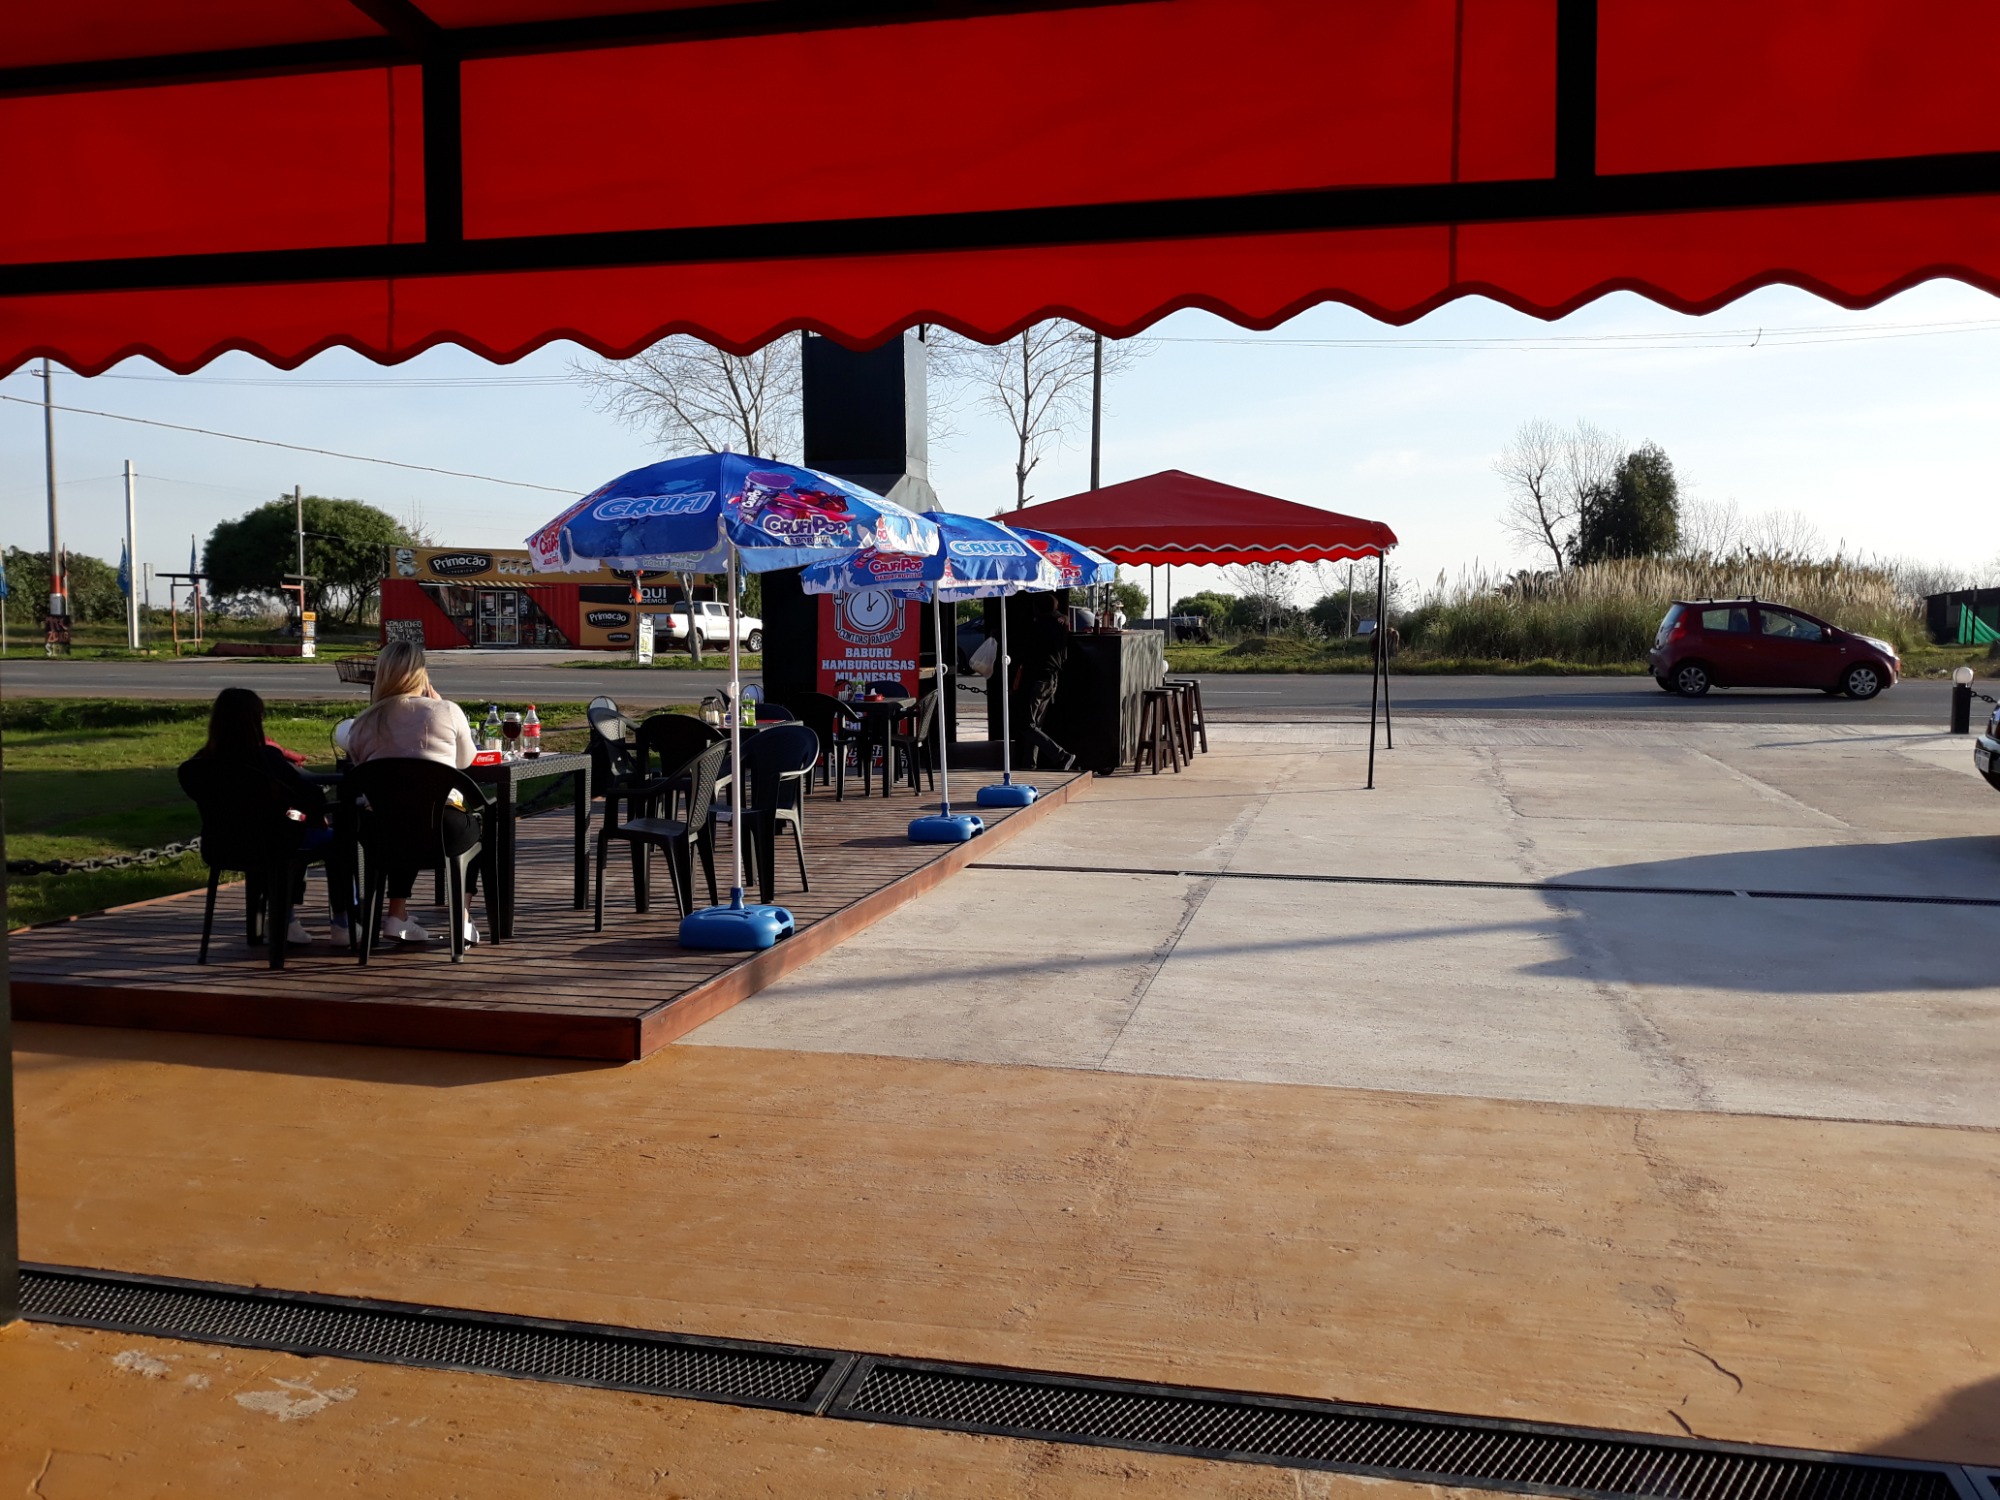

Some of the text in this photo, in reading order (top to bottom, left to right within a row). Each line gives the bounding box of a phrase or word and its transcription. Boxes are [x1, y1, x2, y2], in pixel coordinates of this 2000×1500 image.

[594, 490, 716, 521] CRUFI
[950, 541, 1027, 557] CRUFI
[628, 586, 667, 599] QUÍ
[845, 646, 892, 658] BABURÚ
[822, 660, 915, 670] HAMBURGUESAS
[835, 672, 901, 682] MILANESAS
